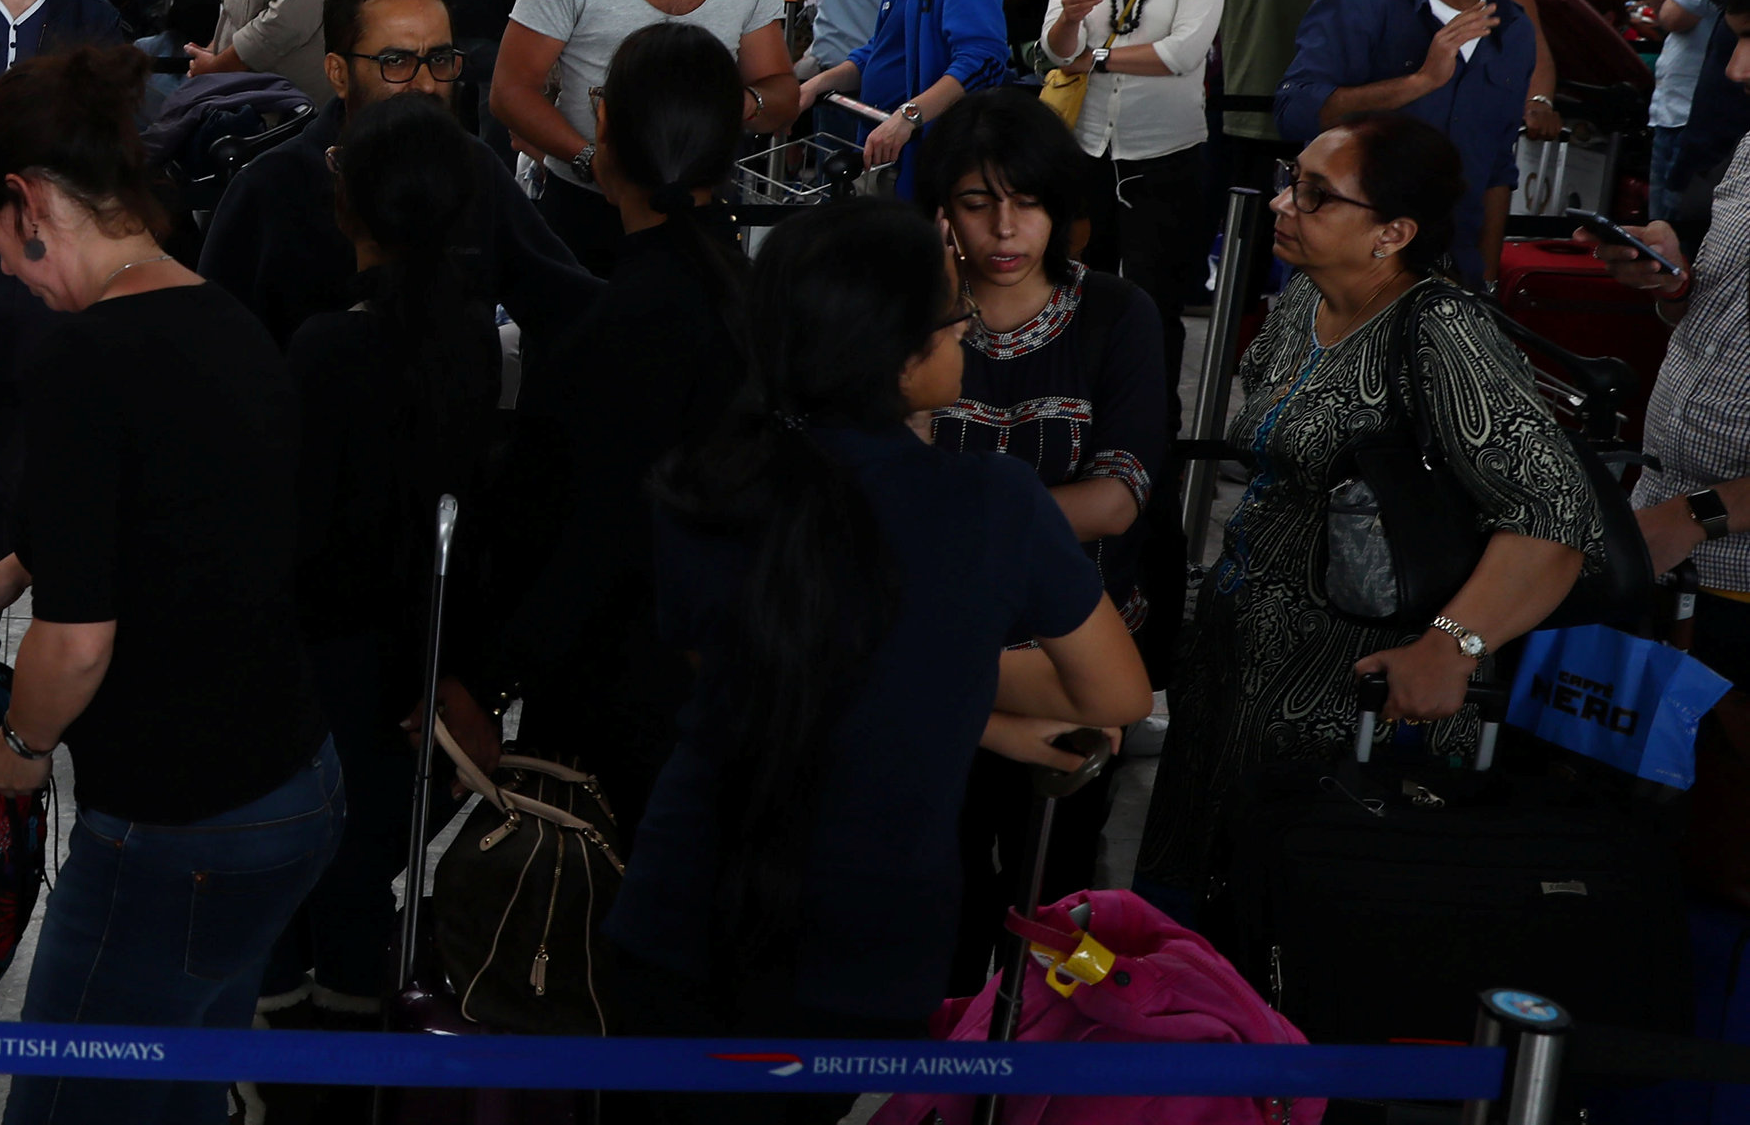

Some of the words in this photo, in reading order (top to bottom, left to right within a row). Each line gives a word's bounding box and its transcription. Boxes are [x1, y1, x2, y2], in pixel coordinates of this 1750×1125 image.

[1530, 679, 1640, 737] NERO
[62, 1039, 165, 1061] AIRWAYS
[812, 1055, 907, 1075] BRITISH
[912, 1057, 1014, 1076] AIRWAYS
